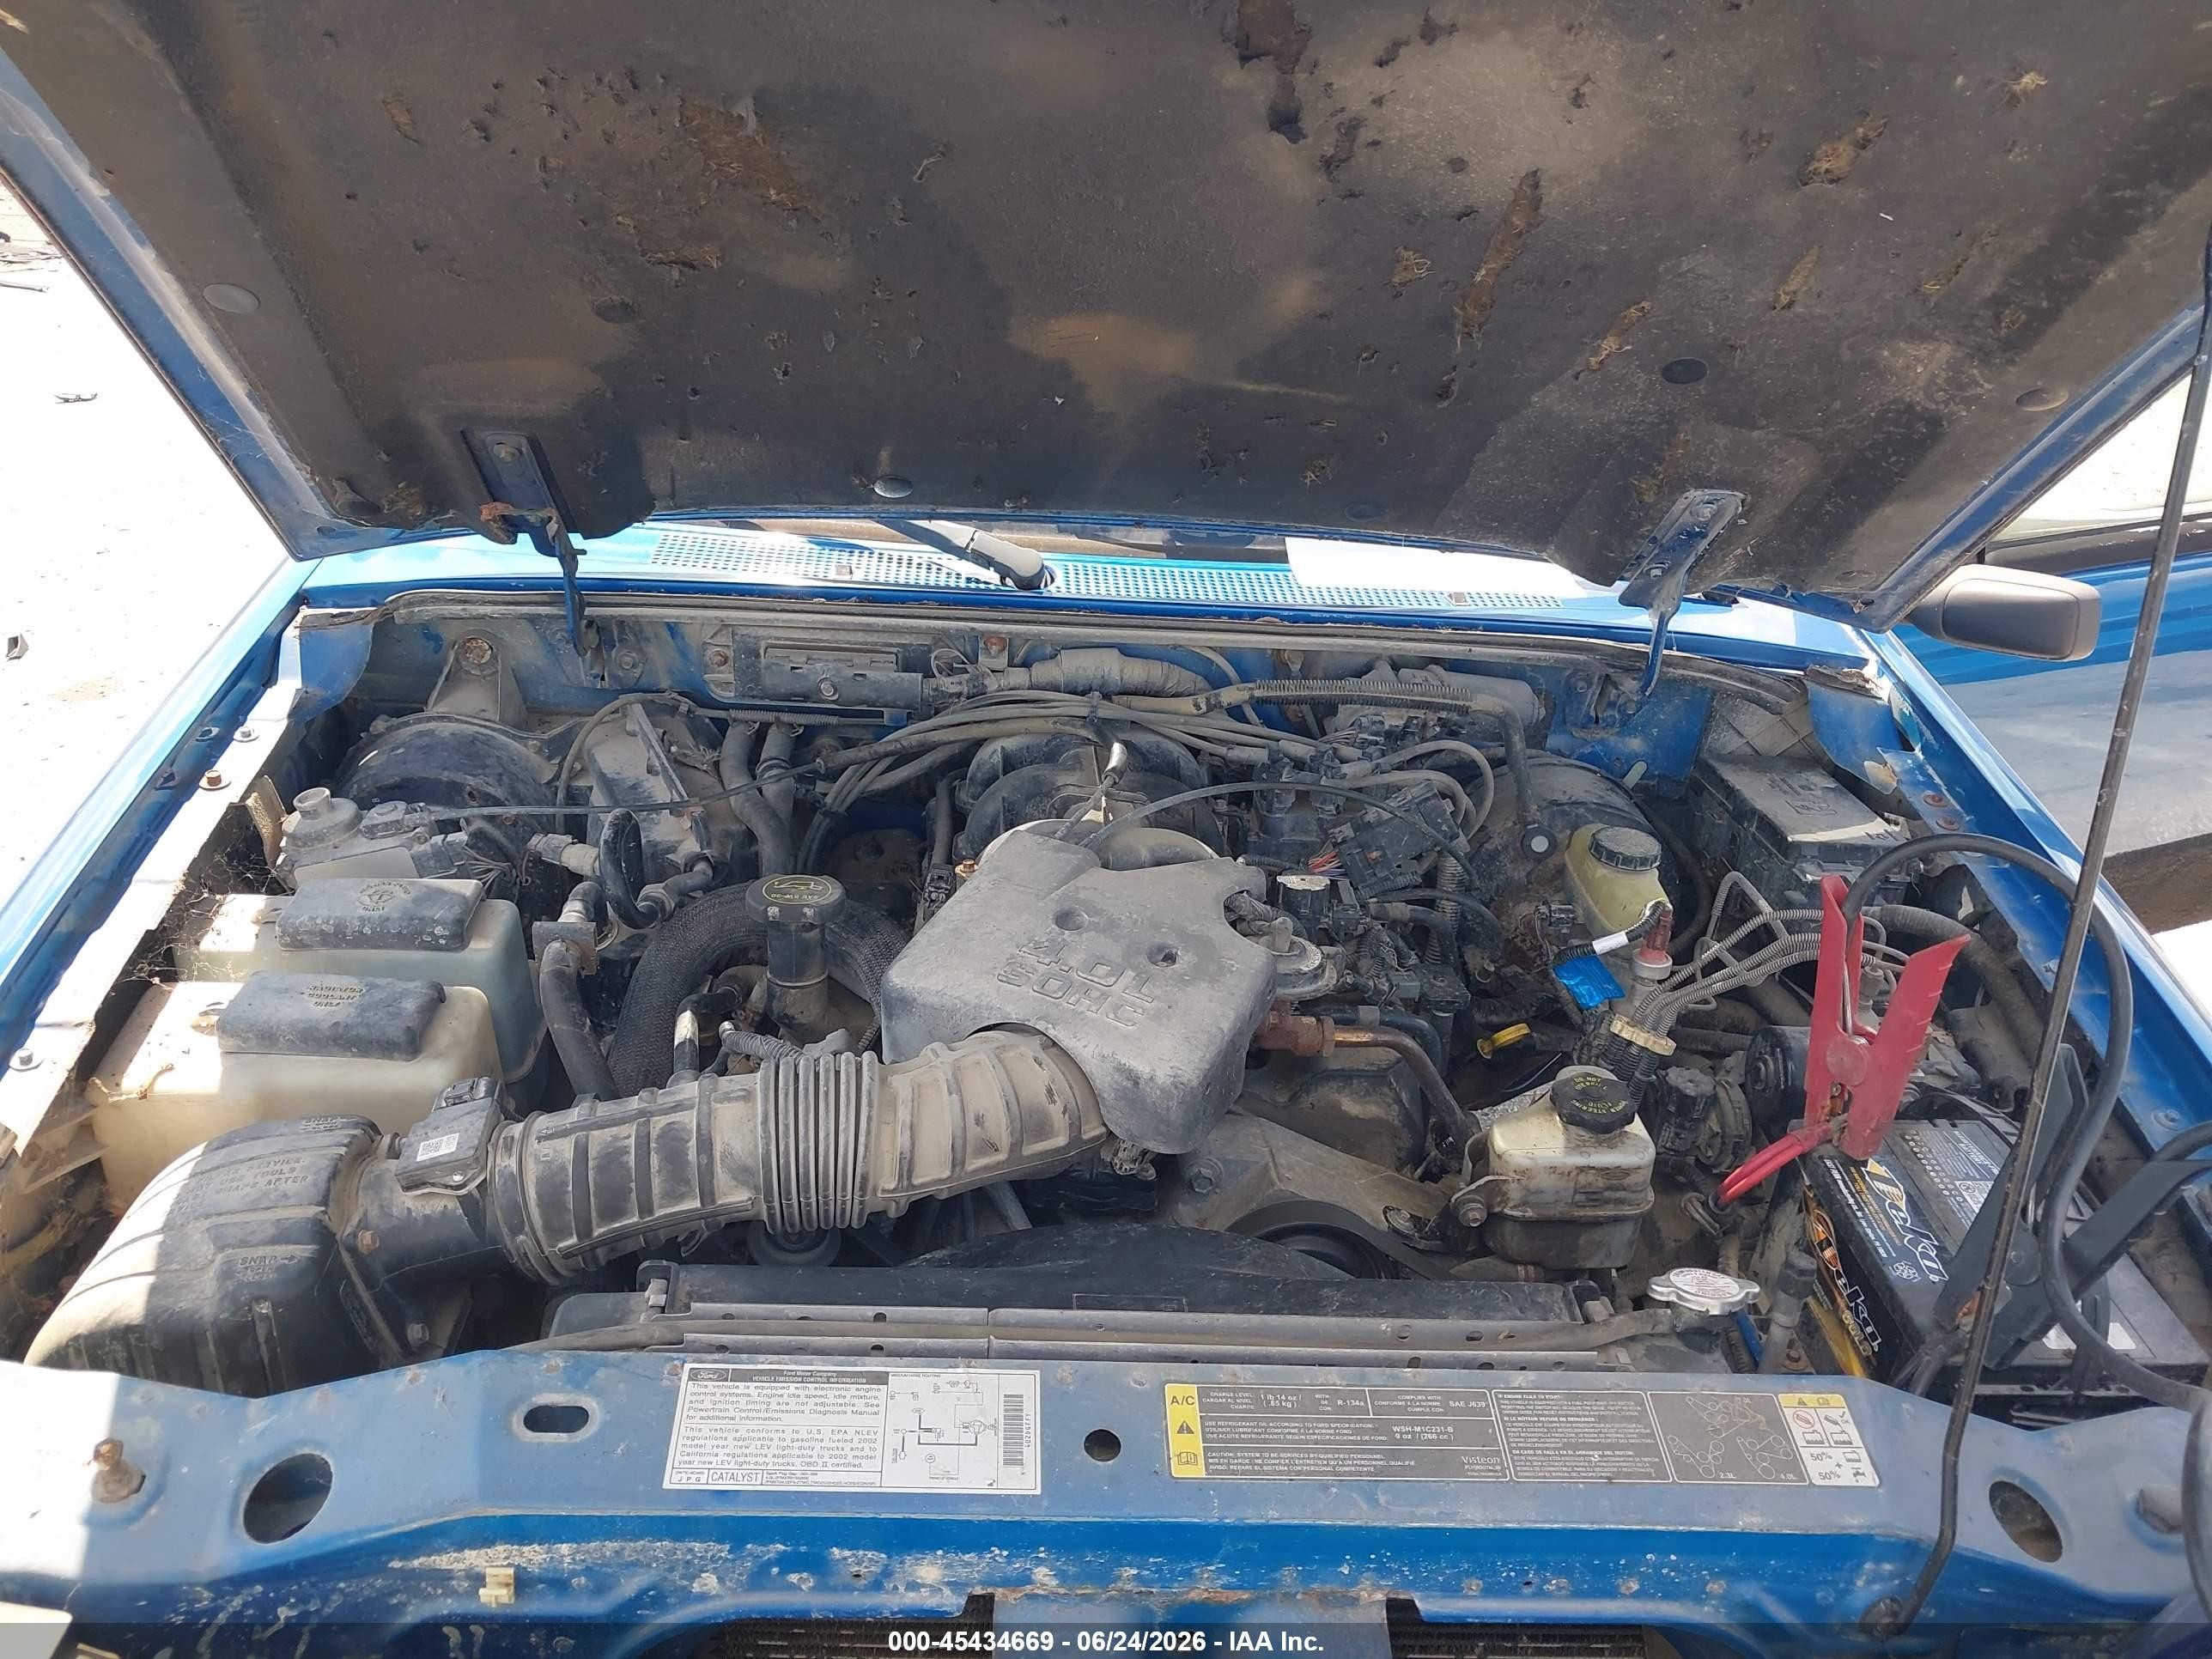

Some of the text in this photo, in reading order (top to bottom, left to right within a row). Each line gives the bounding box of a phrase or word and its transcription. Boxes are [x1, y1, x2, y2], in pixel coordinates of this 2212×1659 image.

[1018, 942, 1154, 1004] 4.0L
[997, 959, 1146, 1027] SOHC
[264, 1175, 309, 1187] AFTER
[697, 1370, 720, 1379] Ford
[754, 1383, 790, 1392] equipped
[855, 1384, 881, 1394] engine
[719, 1390, 753, 1399] systems.
[757, 1390, 785, 1400] Engine
[803, 1391, 829, 1400] speed,
[850, 1392, 879, 1401] mixture,
[1170, 1395, 1196, 1406] A/C
[709, 1397, 740, 1407] ignition
[745, 1398, 771, 1407] timing
[733, 1406, 805, 1416] Control/Emissions
[809, 1407, 847, 1417] Diagnosis
[699, 1413, 736, 1421] additional
[739, 1414, 783, 1422] information.
[682, 1433, 727, 1443] regulations
[732, 1434, 774, 1444] applicable
[790, 1435, 824, 1444] gasoline
[776, 1443, 815, 1452] light-duty
[723, 1450, 767, 1460] regulations
[771, 1451, 813, 1461] applicable
[1810, 1452, 1832, 1461] 50%
[734, 1459, 770, 1468] light-duty
[711, 1471, 760, 1482] CATALYST
[1818, 1472, 1841, 1481] 50%
